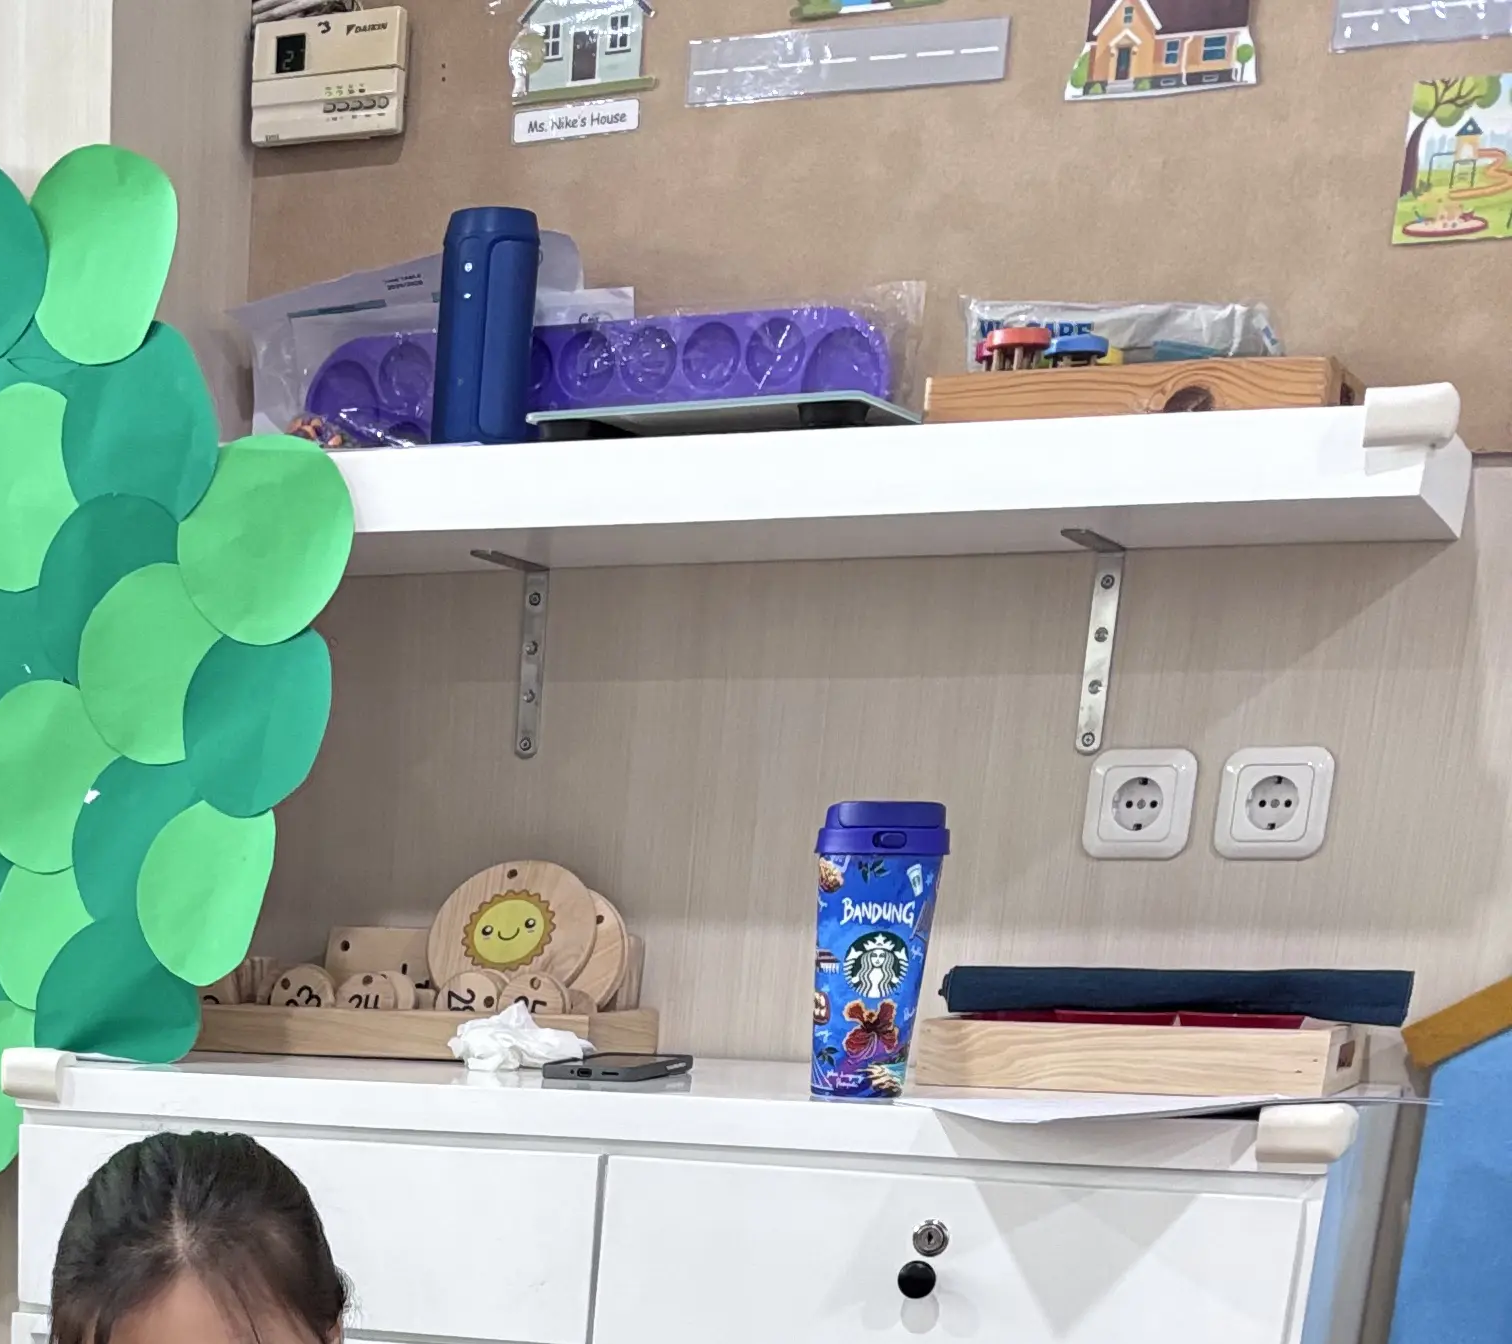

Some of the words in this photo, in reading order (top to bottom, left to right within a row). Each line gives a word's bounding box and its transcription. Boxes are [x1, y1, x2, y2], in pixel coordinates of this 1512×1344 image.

[528, 120, 548, 134] Ms.
[590, 111, 628, 127] House
[839, 896, 916, 929] BANDUNG
